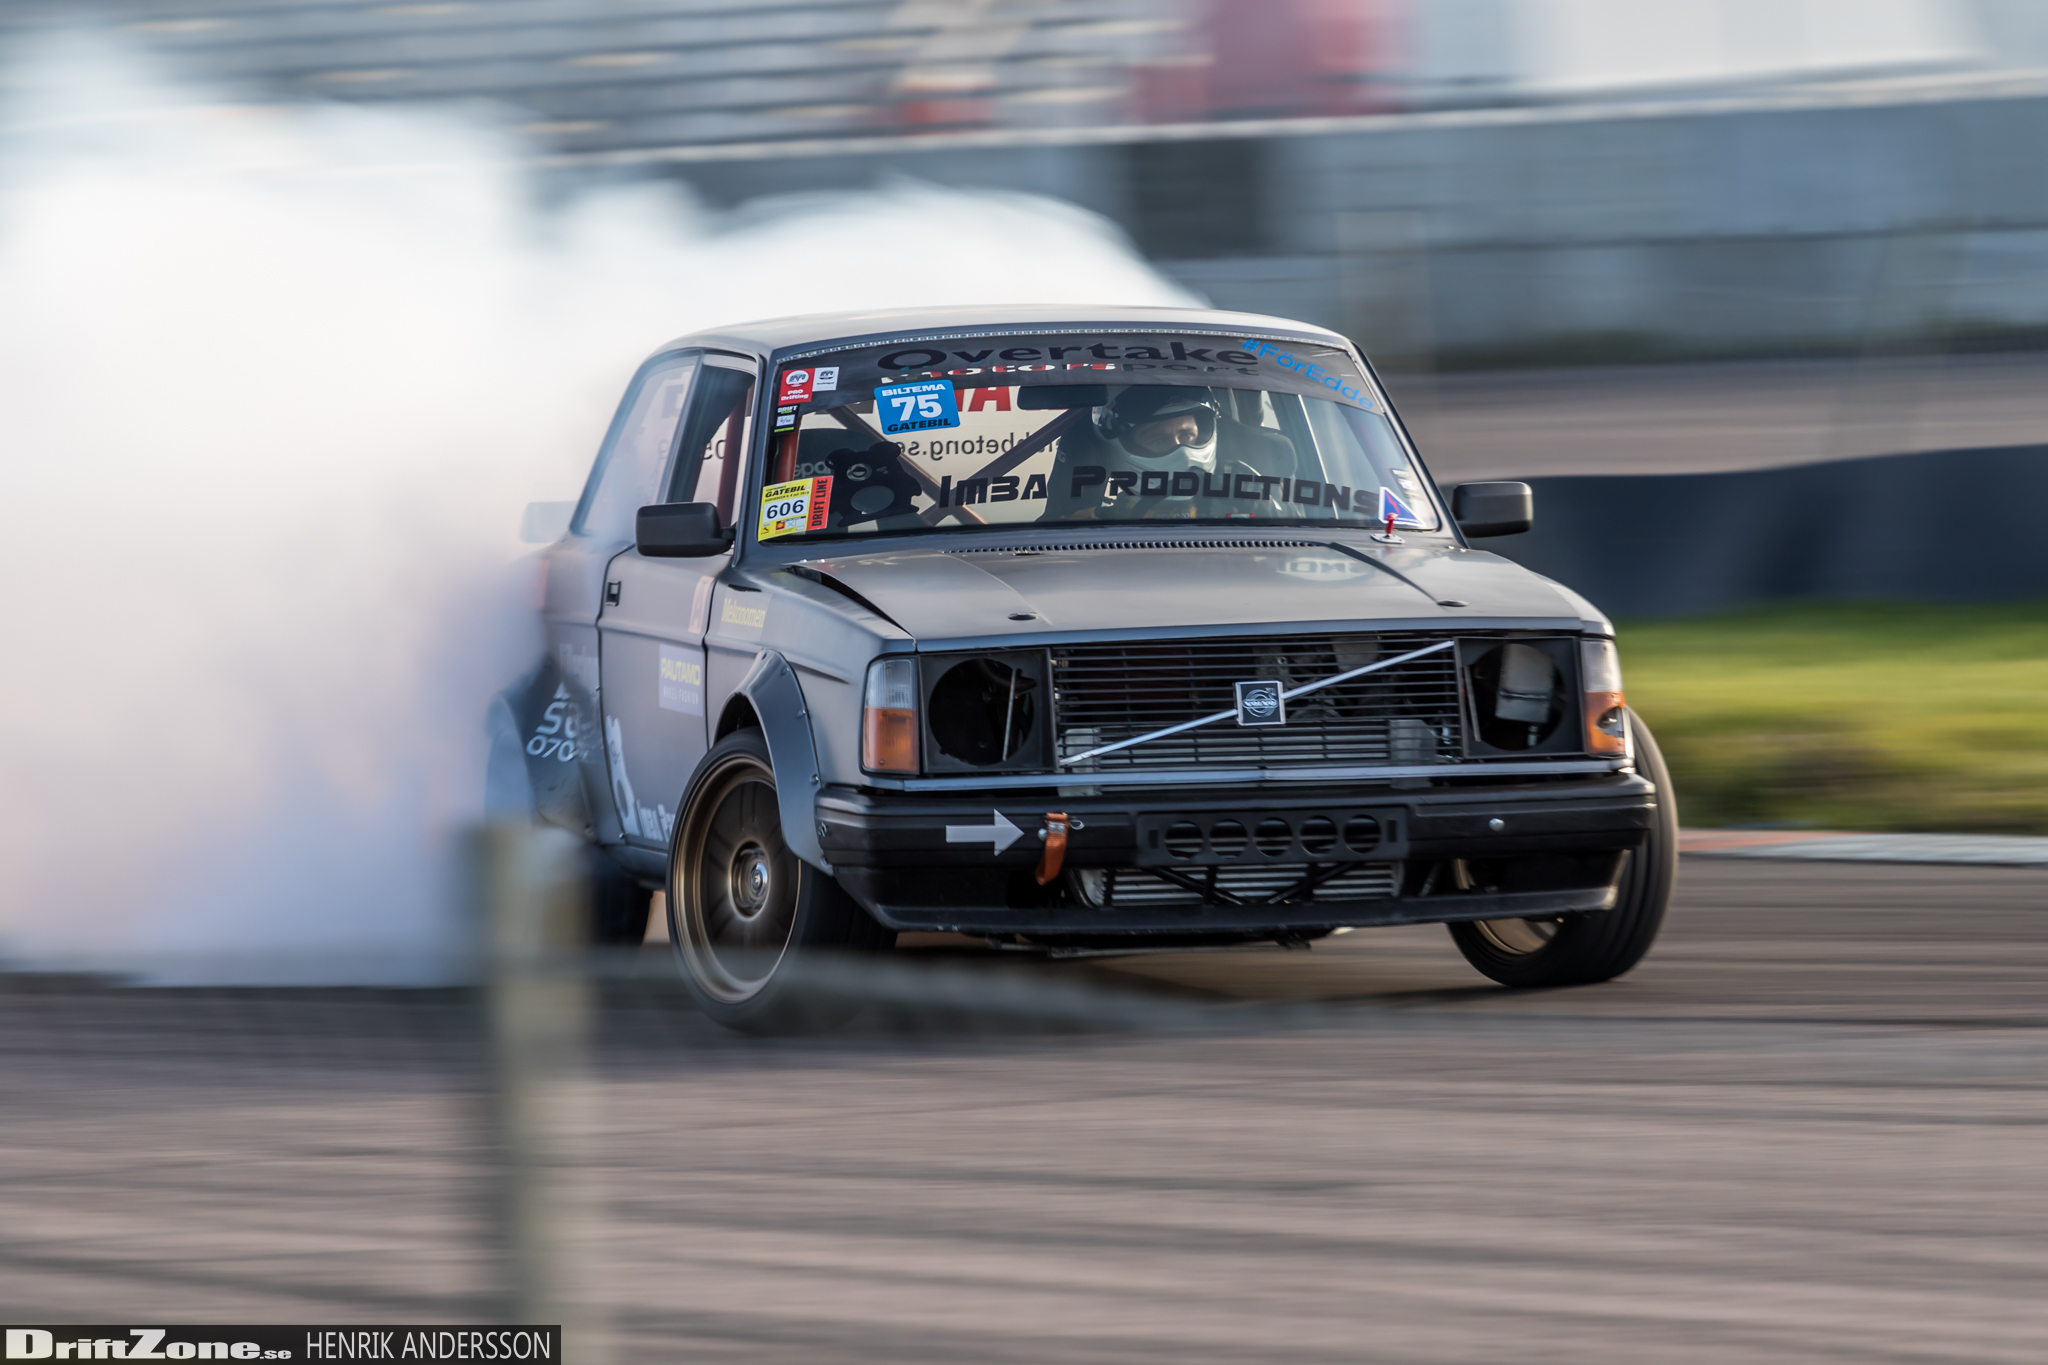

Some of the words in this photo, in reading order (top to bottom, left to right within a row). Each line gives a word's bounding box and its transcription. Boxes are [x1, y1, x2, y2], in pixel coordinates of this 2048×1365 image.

[877, 341, 1259, 371] Overtake
[881, 362, 1260, 385] motorsport
[1242, 338, 1374, 410] #FörEdde
[881, 383, 947, 397] BILTEMA
[891, 393, 943, 421] 75
[887, 418, 952, 433] GATEBIL
[765, 484, 806, 498] GATEBIL
[814, 478, 828, 499] LINE
[1071, 466, 1379, 517] PRODUCTIONS
[766, 499, 805, 520] 606
[811, 501, 825, 527] DRIFT
[720, 597, 766, 629] Mekonomen
[661, 657, 701, 687] RAUTAMO
